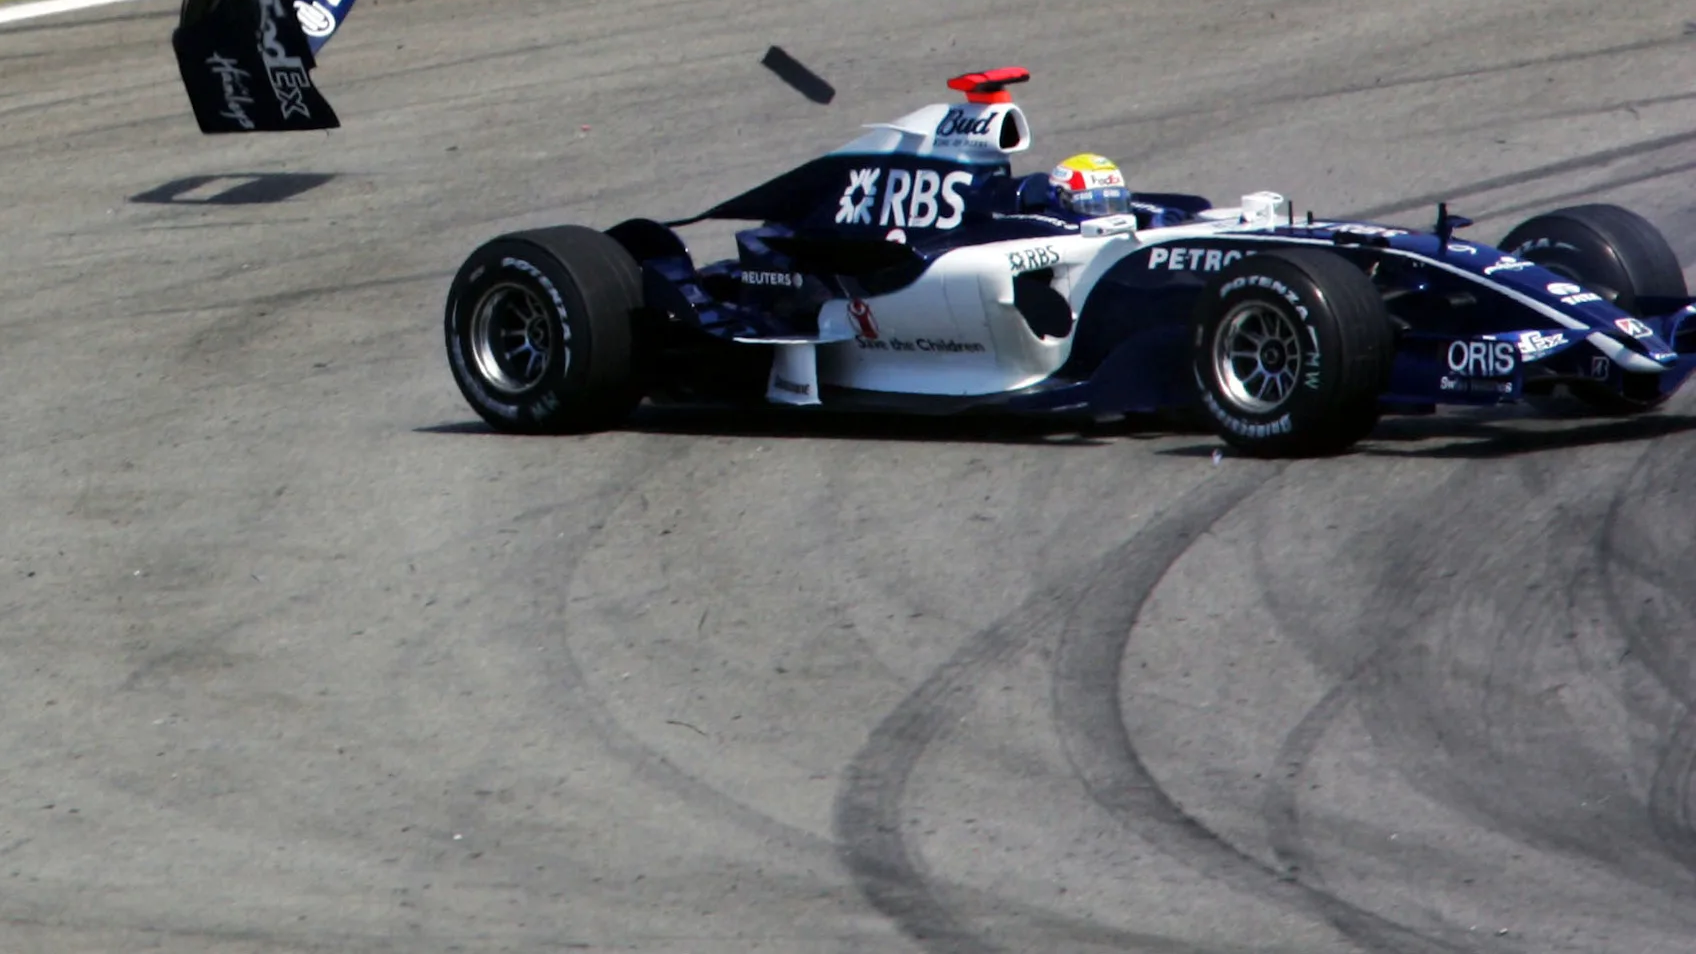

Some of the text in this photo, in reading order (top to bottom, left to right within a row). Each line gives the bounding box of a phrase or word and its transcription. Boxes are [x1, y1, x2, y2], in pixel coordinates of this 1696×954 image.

[936, 108, 998, 137] Bud
[879, 169, 973, 230] RBS
[1027, 246, 1060, 268] RBS
[741, 271, 791, 286] REUTERS
[855, 335, 986, 353] Save the Children
[1447, 340, 1515, 375] ORIS
